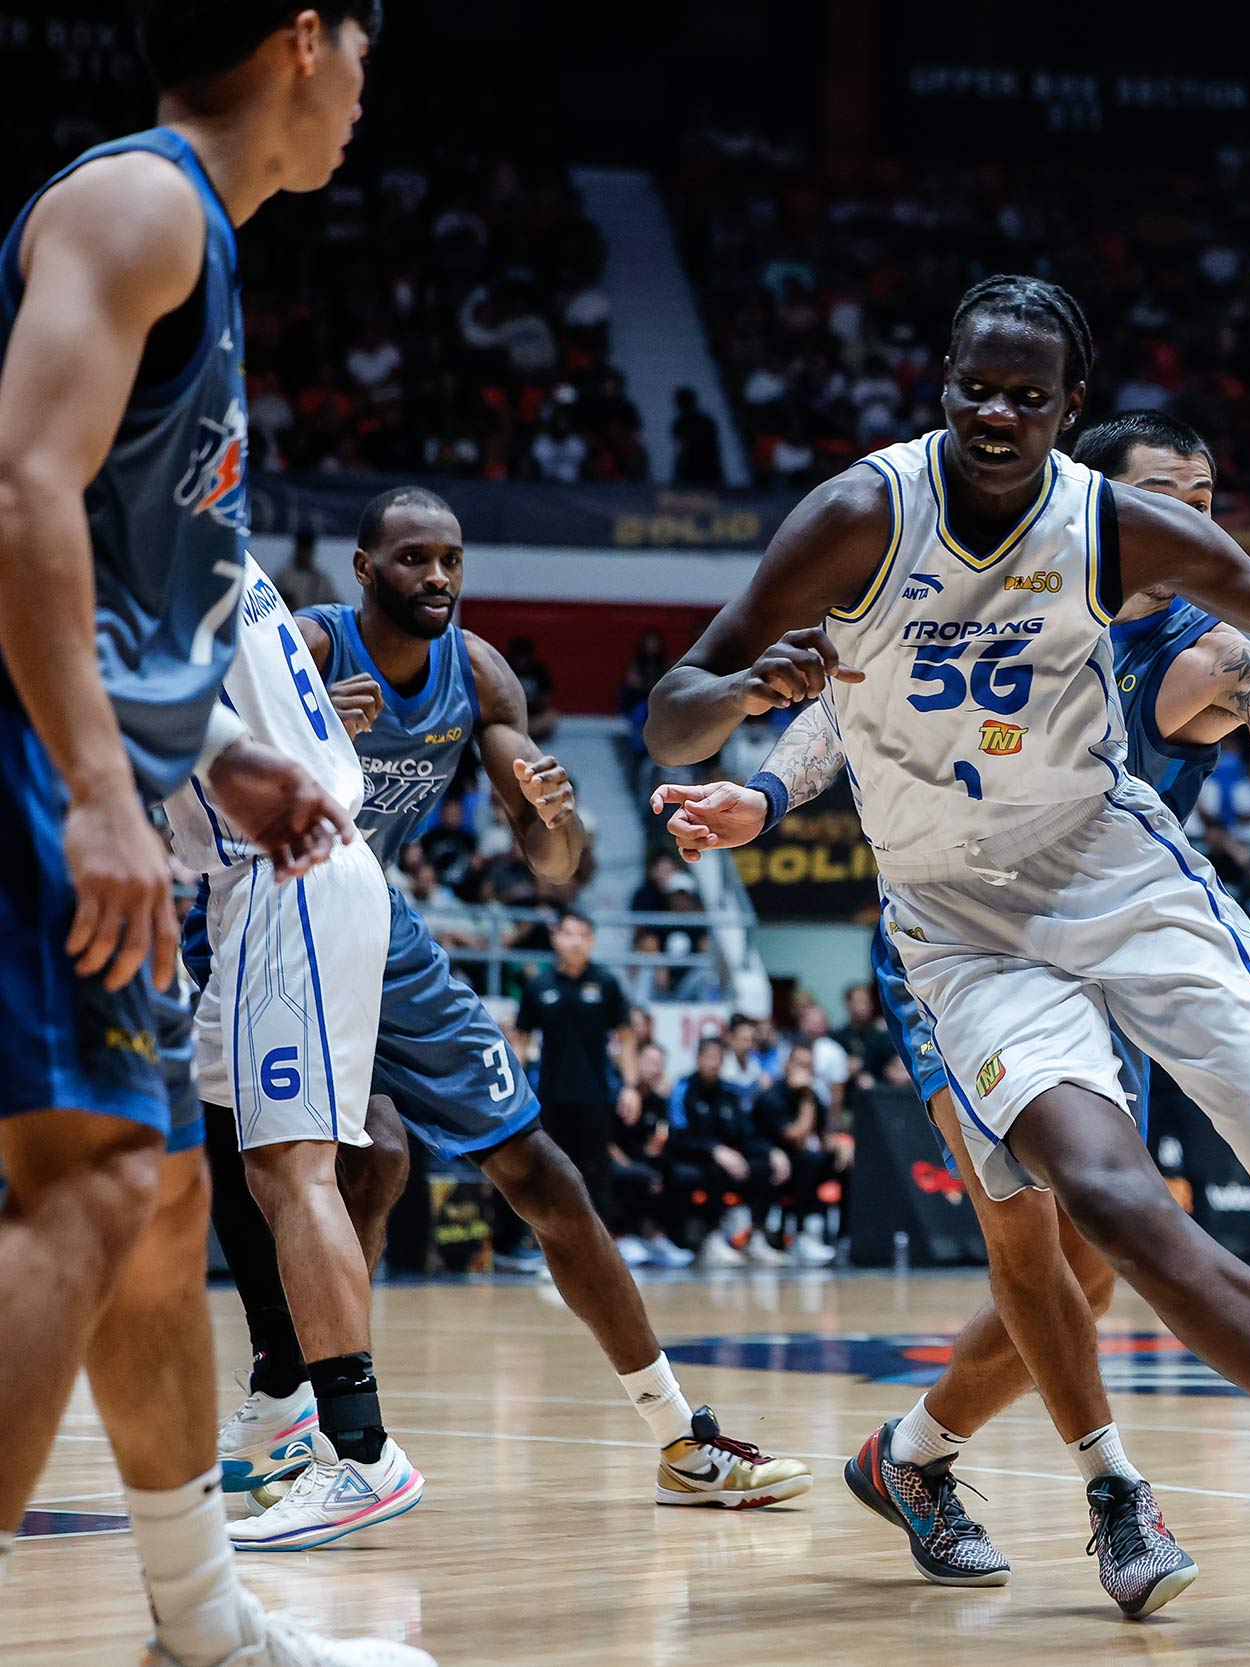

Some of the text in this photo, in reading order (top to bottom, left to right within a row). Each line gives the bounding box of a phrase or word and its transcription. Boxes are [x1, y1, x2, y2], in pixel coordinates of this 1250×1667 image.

[902, 587, 930, 601] ANTA
[902, 617, 1046, 641] TROPANG
[904, 638, 1035, 716] 5G
[978, 726, 1030, 751] TNT
[358, 756, 434, 778] ERALCO
[732, 844, 880, 887] SOLI
[260, 1044, 301, 1102] 6
[482, 1039, 515, 1103] 3
